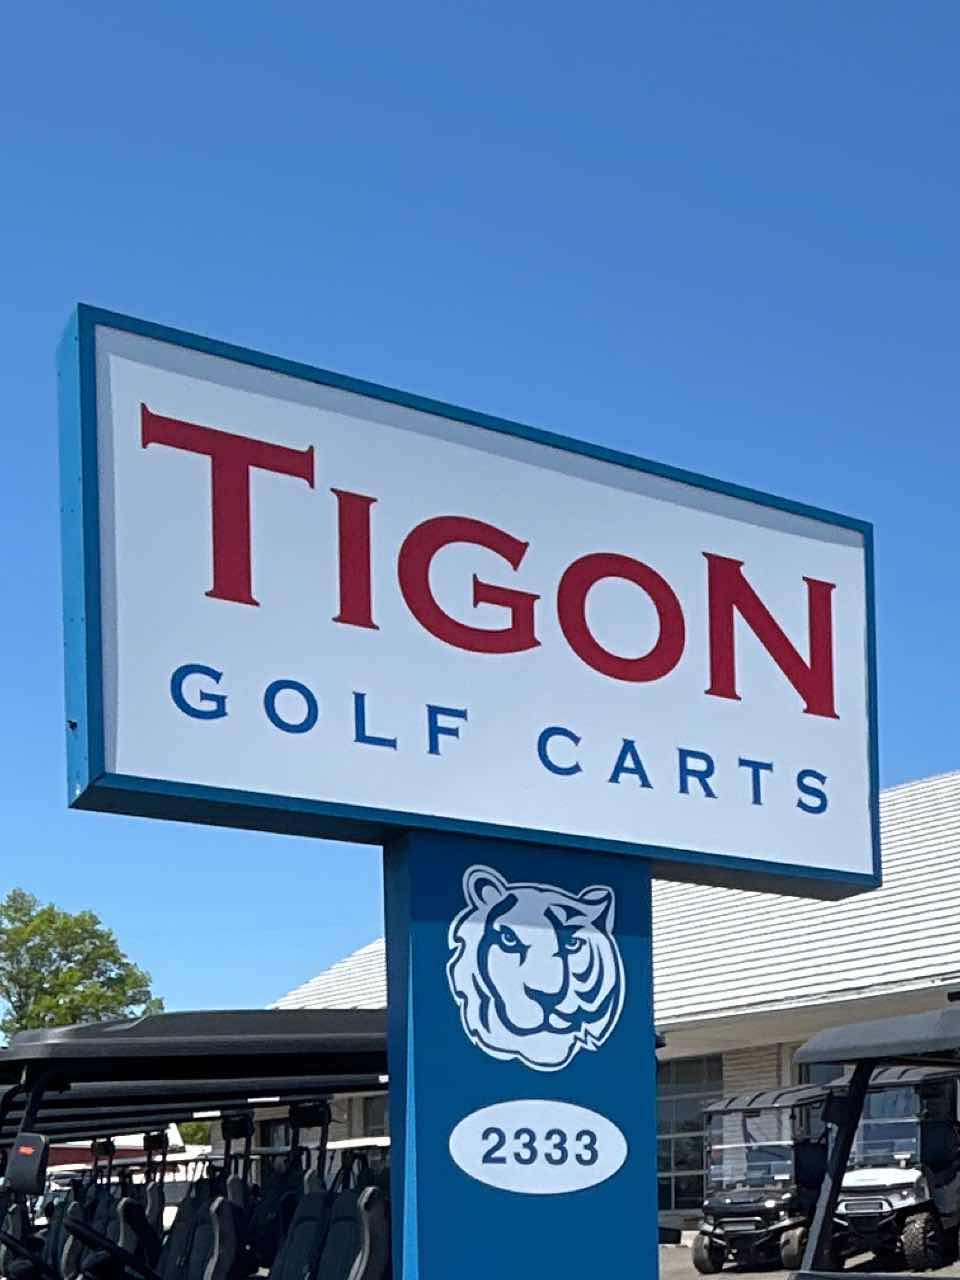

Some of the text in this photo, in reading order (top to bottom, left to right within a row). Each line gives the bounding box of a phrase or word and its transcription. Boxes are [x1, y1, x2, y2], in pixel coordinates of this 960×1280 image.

[141, 402, 840, 720] TIGON
[170, 663, 829, 815] GOLF CARTS
[481, 1126, 600, 1167] 2333
